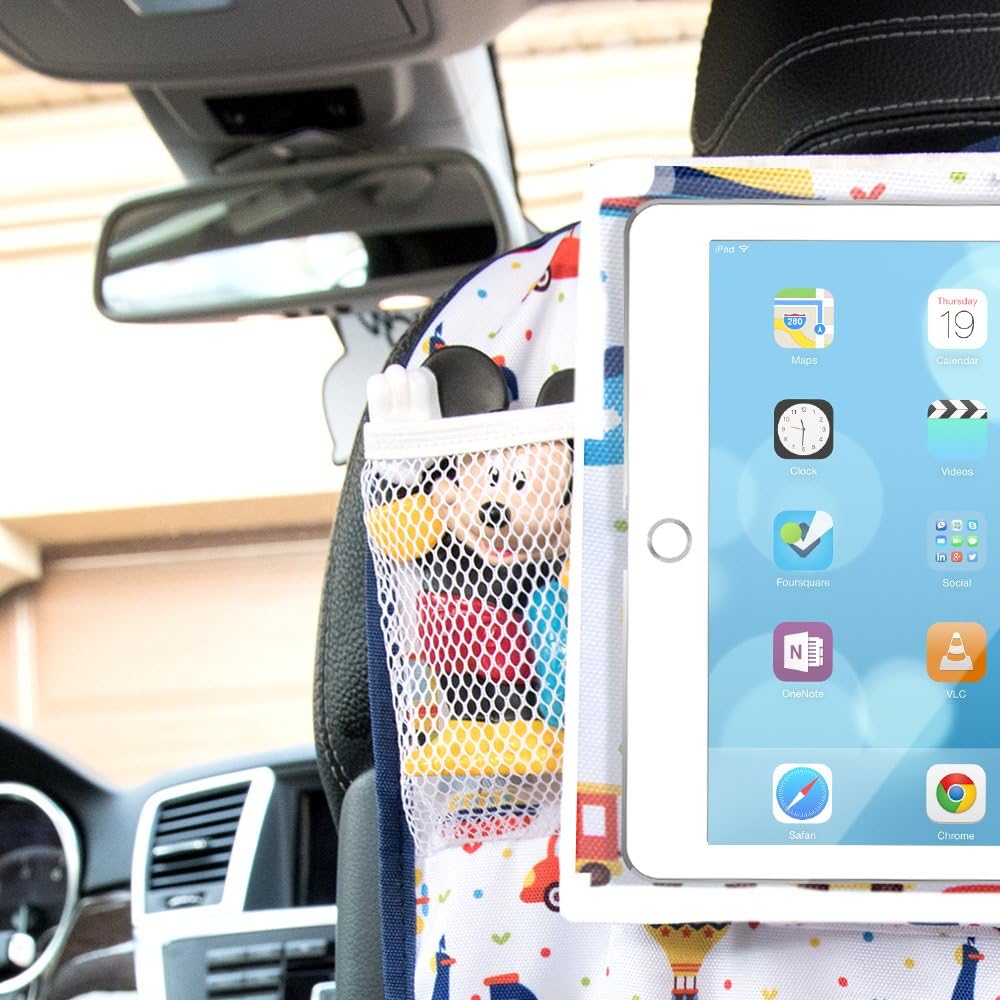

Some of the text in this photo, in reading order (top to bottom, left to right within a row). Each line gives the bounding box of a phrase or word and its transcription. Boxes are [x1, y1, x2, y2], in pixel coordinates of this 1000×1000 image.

[715, 245, 735, 254] iPad
[937, 297, 978, 307] Thursday
[787, 317, 803, 325] 280
[940, 310, 975, 339] 19
[791, 355, 818, 366] Maps
[936, 355, 979, 365] Calendar
[790, 466, 817, 476] Clock
[942, 466, 973, 476] Videos
[936, 552, 946, 562] in
[776, 577, 830, 588] Foursquare
[943, 578, 971, 588] Social
[790, 645, 802, 660] N
[782, 689, 824, 699] OneNote
[946, 689, 967, 699] VLC
[789, 830, 816, 840] Safari
[937, 831, 975, 841] Chrome
